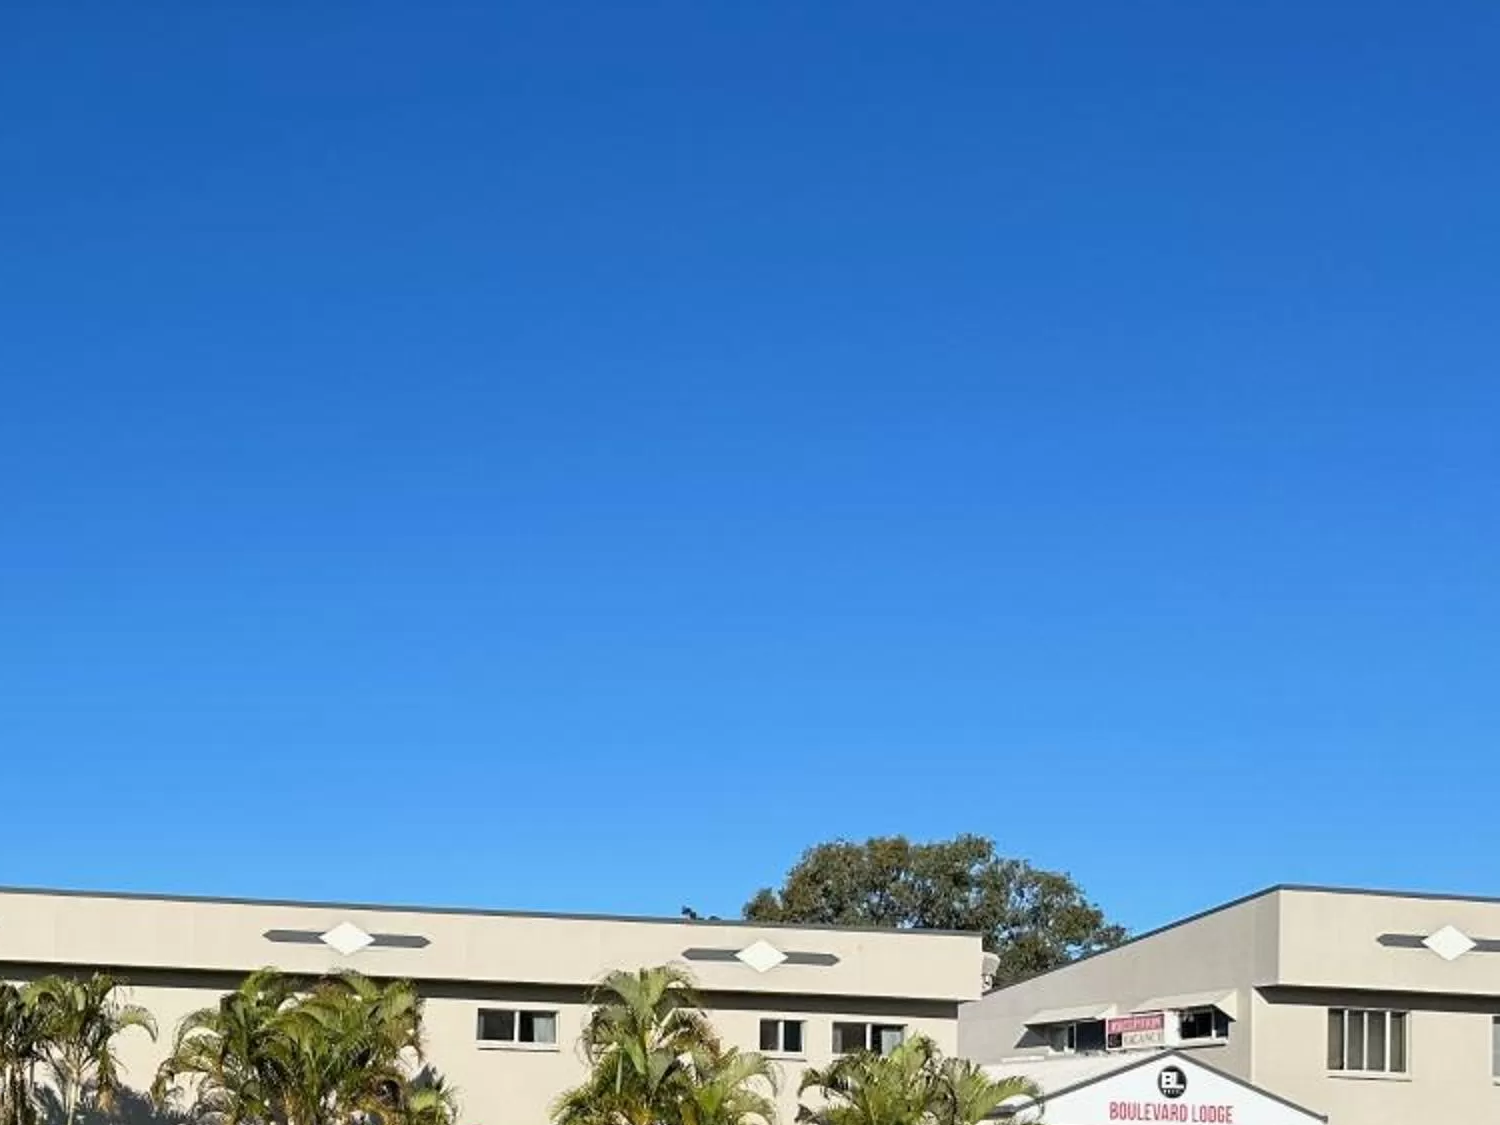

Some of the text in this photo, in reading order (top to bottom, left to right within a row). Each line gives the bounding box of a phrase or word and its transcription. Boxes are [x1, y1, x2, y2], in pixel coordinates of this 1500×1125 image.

[1161, 1071, 1185, 1089] BL
[1109, 1101, 1233, 1123] BOULEVARD LODGE
